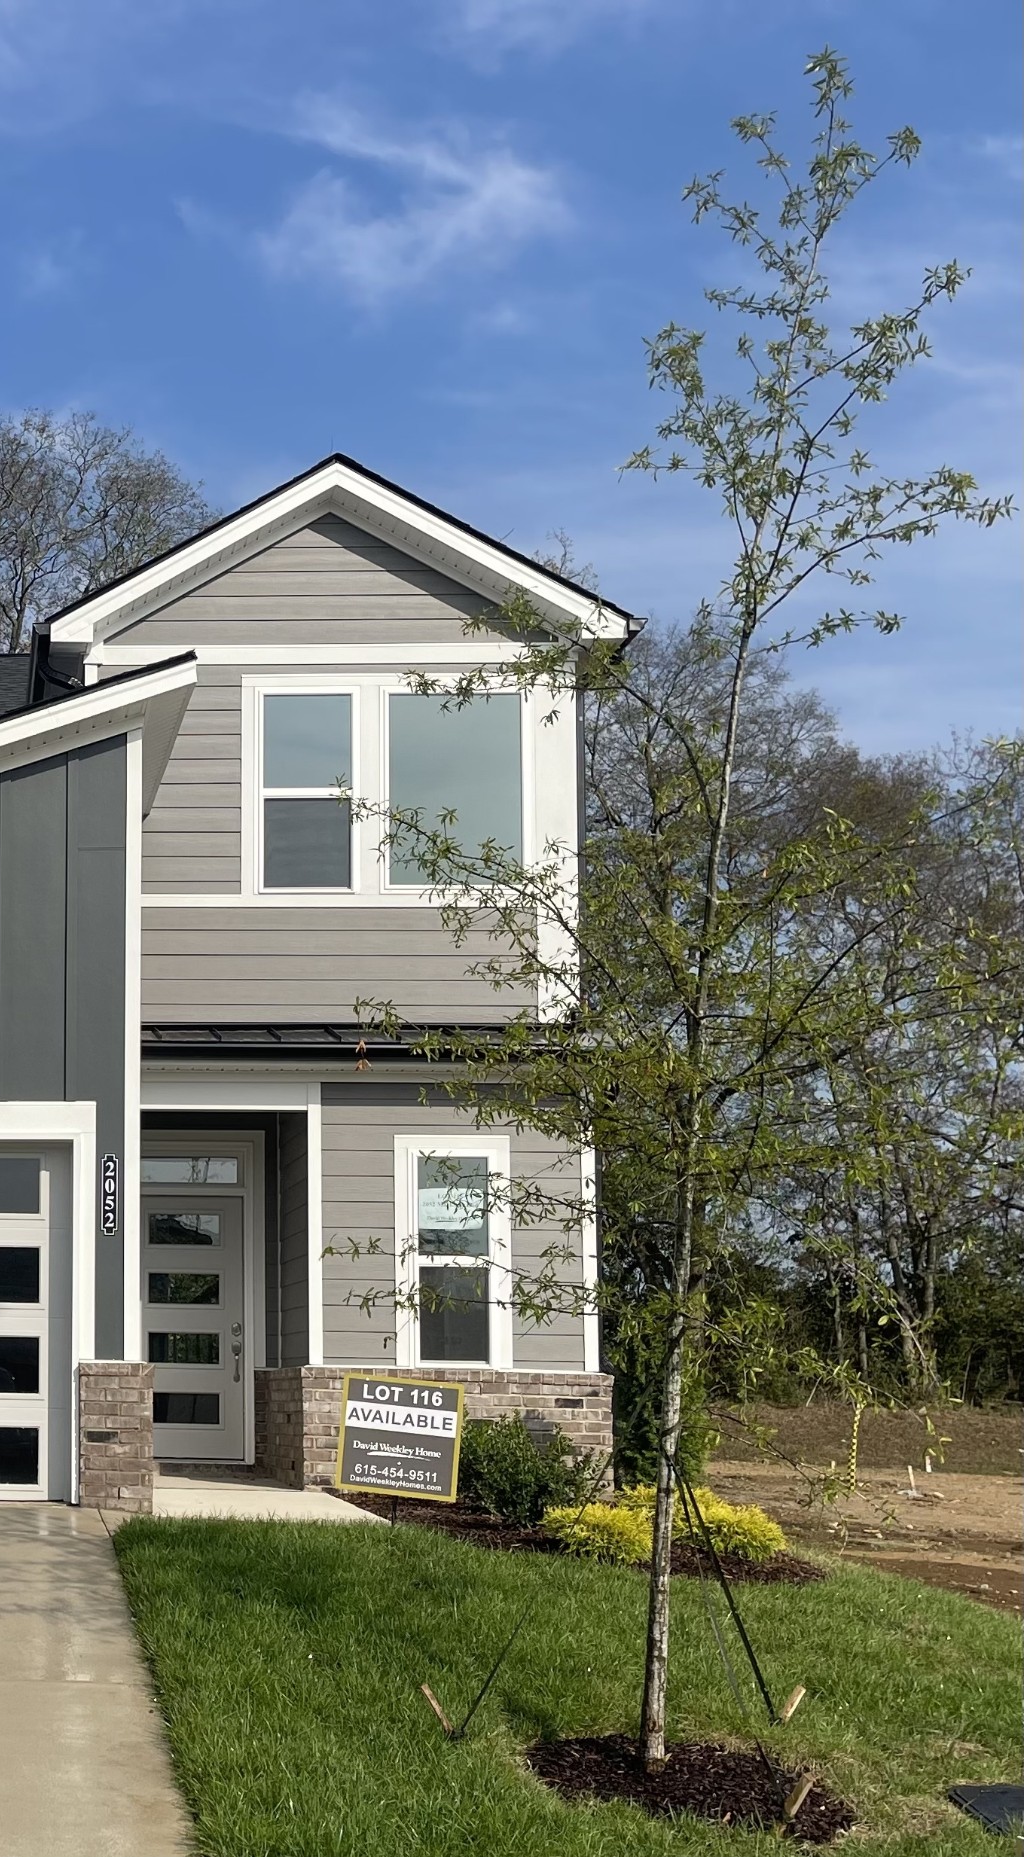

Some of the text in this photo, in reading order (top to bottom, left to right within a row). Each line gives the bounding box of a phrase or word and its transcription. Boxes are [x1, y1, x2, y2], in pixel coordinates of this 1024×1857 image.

[104, 1161, 115, 1228] 2052
[363, 1383, 443, 1407] LOT 116
[348, 1407, 454, 1431] AVAILABLE
[353, 1440, 442, 1459] David Weekley Home
[349, 1474, 442, 1492] DavidWeekleyHomes.com
[354, 1463, 438, 1483] 615-454-9511
